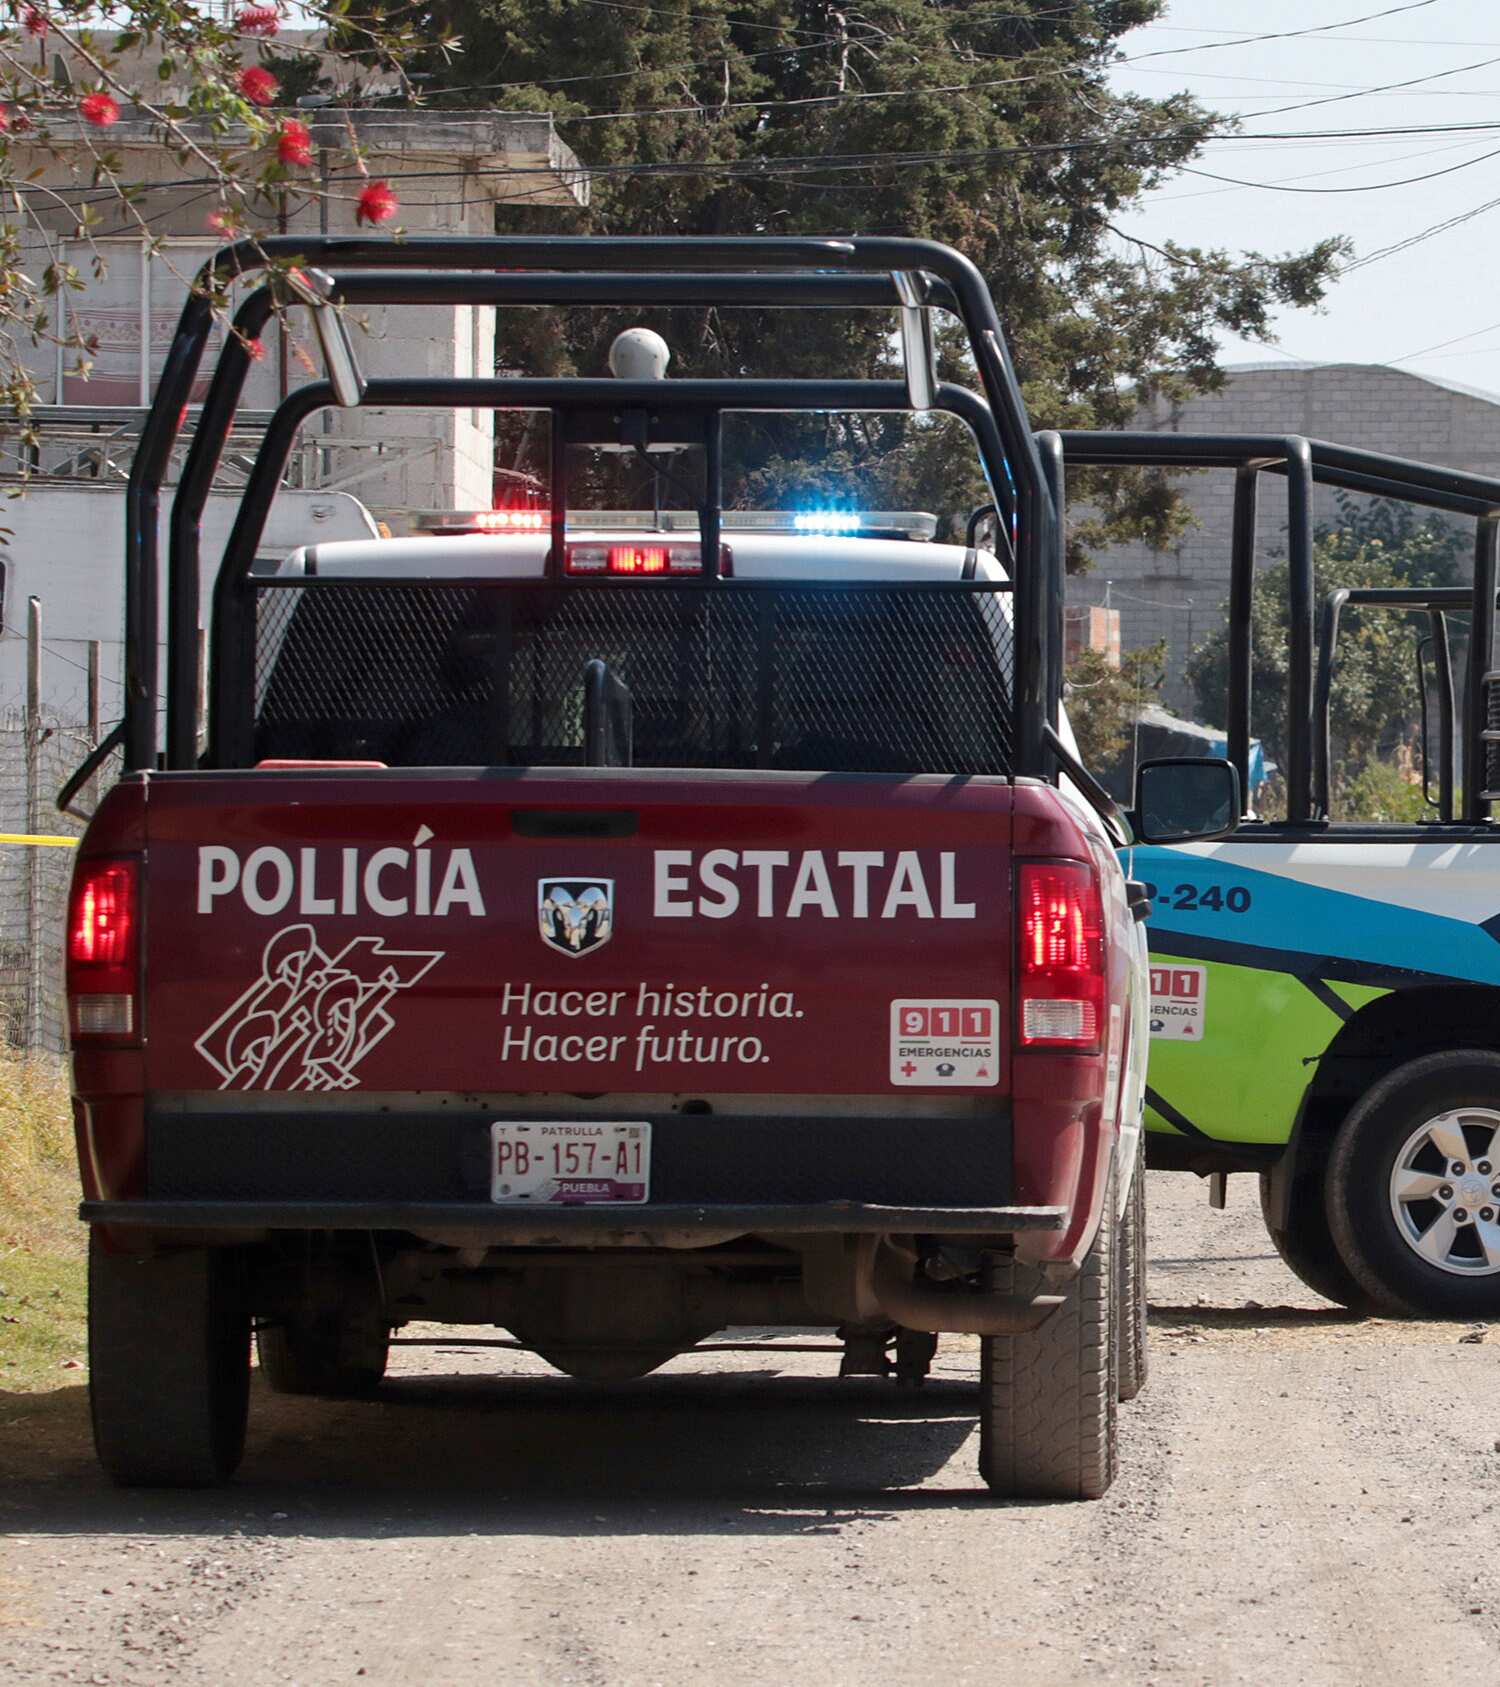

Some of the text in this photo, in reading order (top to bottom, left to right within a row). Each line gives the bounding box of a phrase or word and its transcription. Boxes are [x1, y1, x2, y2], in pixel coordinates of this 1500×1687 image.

[197, 824, 976, 919] POLICÍA ESTATAL
[1145, 882, 1252, 913] -240
[501, 982, 804, 1018] Hacer historia.
[905, 1011, 982, 1033] 911
[501, 1025, 770, 1072] Hacer futuro.
[899, 1047, 992, 1058] EMERGENCIAS
[541, 1127, 603, 1136] PATRULLA
[498, 1141, 641, 1175] PB-157-A1
[562, 1183, 610, 1193] PUEBLA
